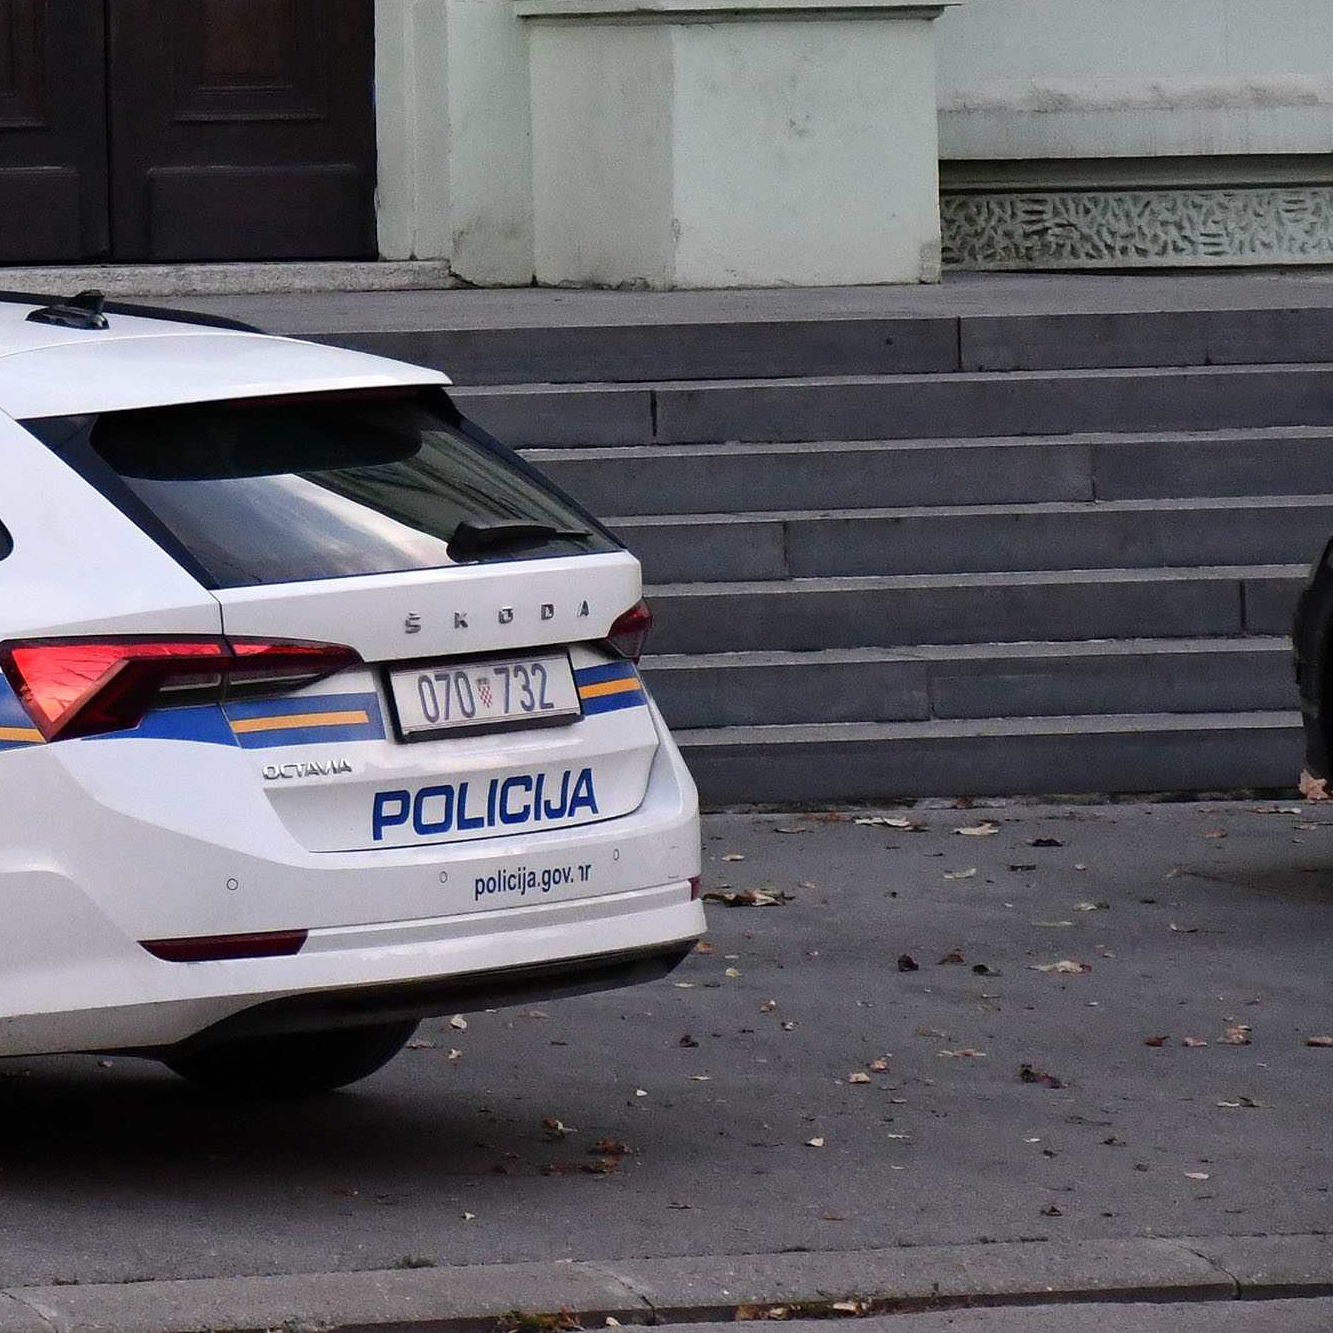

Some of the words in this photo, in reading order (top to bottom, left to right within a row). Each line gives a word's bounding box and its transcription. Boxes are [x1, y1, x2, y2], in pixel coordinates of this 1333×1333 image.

[405, 600, 590, 635] ŠKODA
[417, 671, 476, 723] 070
[493, 663, 554, 714] 732
[262, 758, 352, 780] OCTAVIA
[372, 768, 599, 841] POLICIJA
